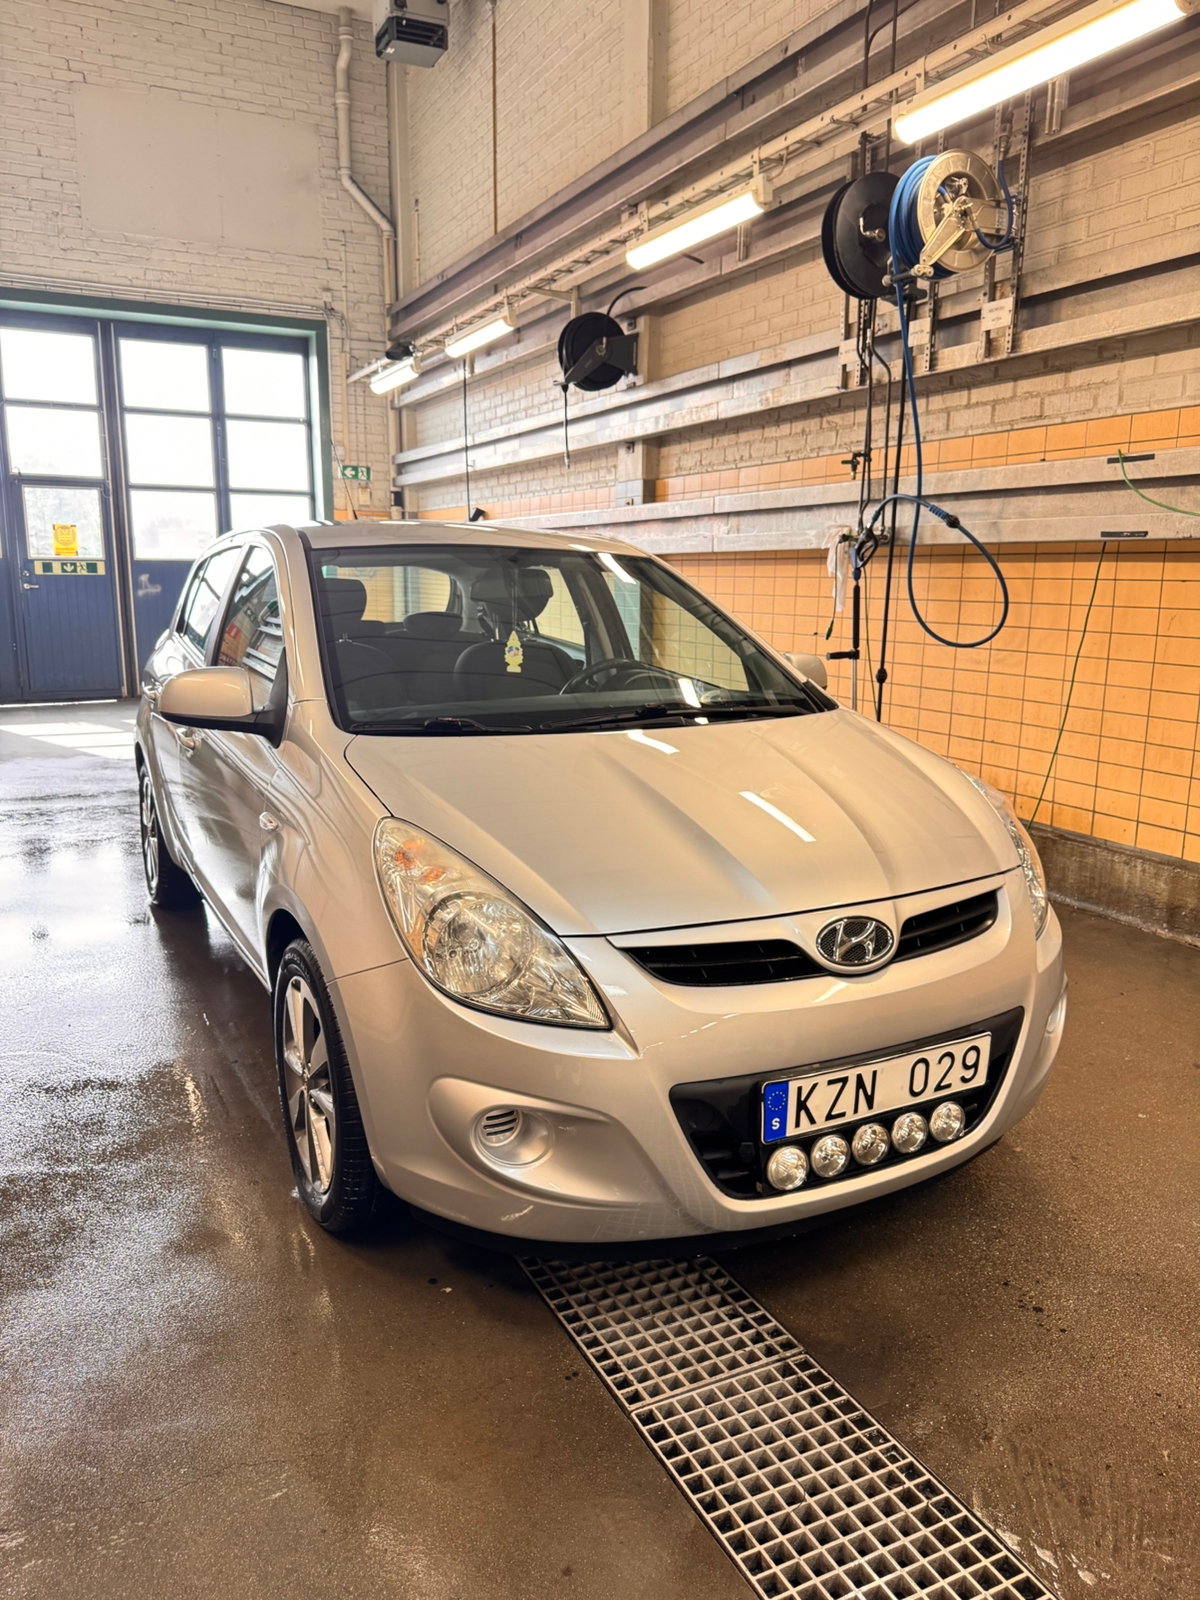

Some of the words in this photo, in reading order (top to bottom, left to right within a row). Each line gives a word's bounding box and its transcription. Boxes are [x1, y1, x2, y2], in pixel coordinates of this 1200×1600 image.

[794, 1069, 878, 1128] KZN
[908, 1045, 980, 1098] 029
[771, 1117, 781, 1130] S
